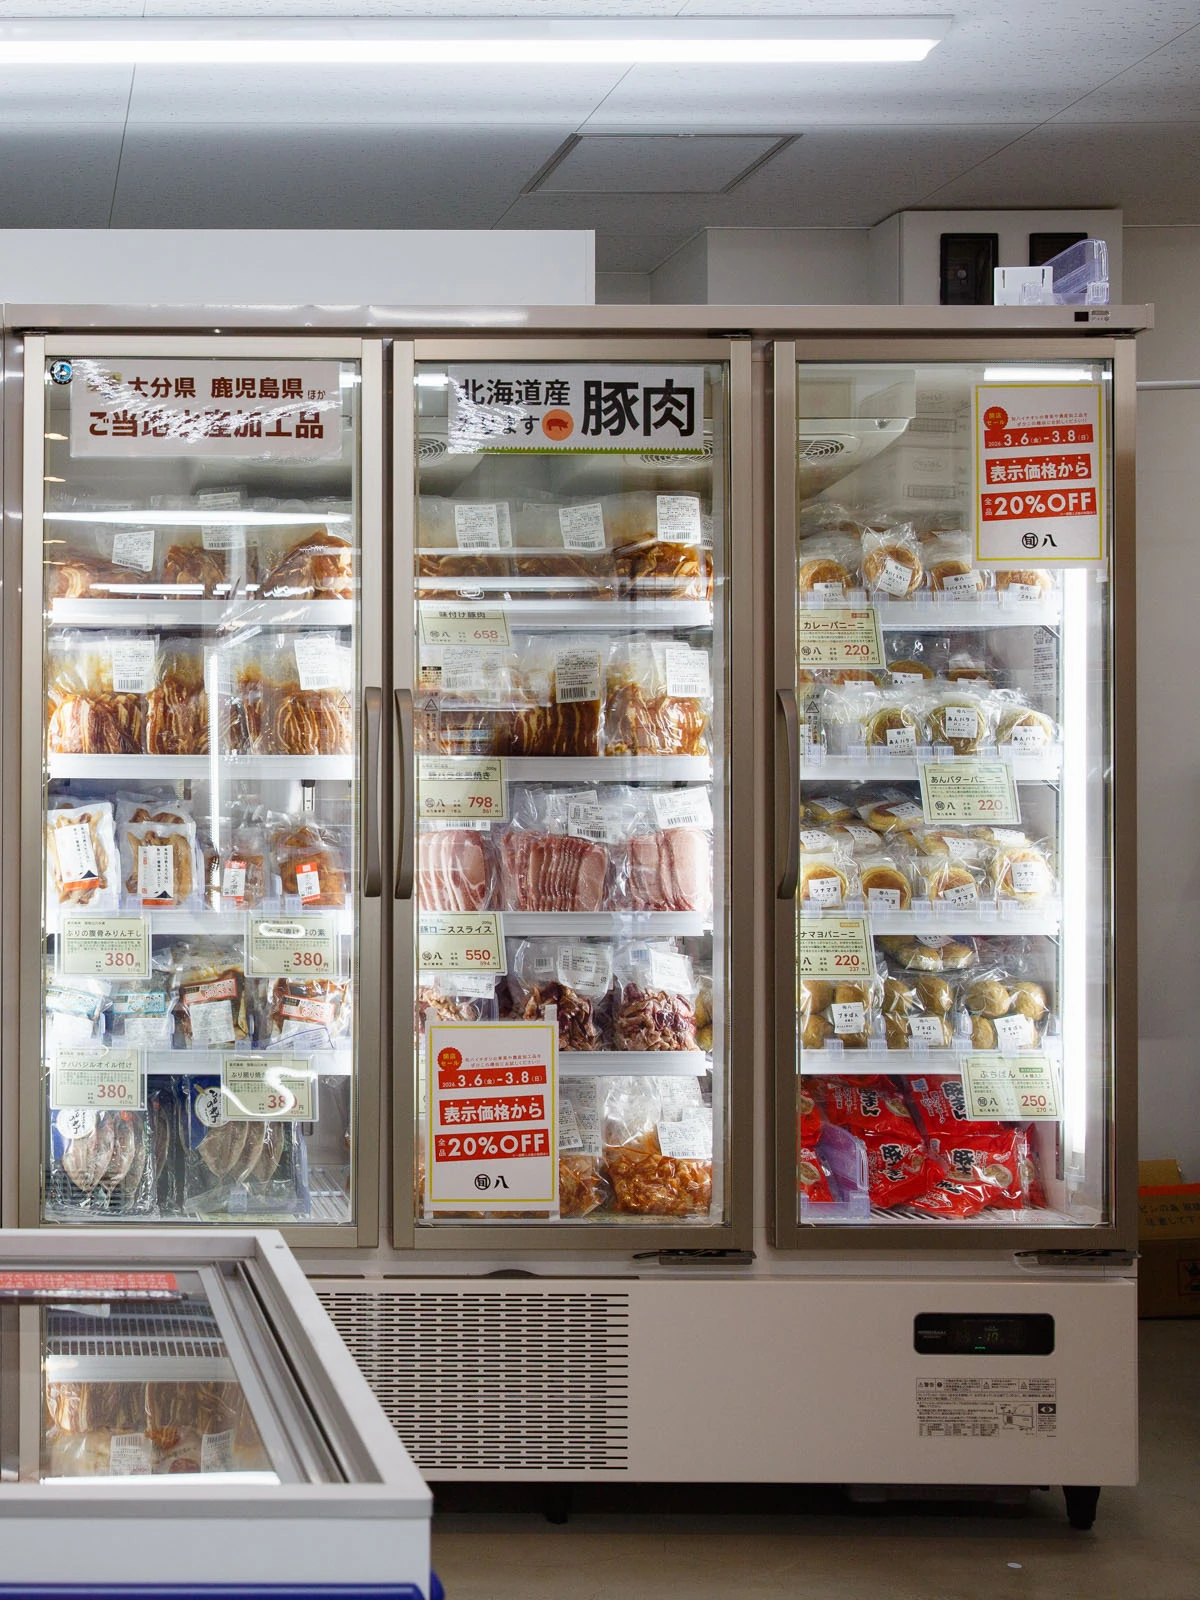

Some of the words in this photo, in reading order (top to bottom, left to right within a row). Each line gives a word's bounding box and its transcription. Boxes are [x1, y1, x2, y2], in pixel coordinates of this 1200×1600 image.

[128, 377, 196, 398] 大分県
[210, 376, 304, 400] 鹿児島県
[308, 389, 326, 400] ほか
[458, 379, 570, 406] 北海道産
[581, 379, 695, 437] 豚肉
[990, 461, 1089, 482] 表示価格から
[994, 492, 1091, 516] 20%OFF
[1022, 532, 1057, 549] 旬八
[474, 630, 498, 639] 658
[844, 644, 870, 656] 220
[468, 796, 492, 808] 798
[978, 800, 1002, 810] 220
[466, 950, 490, 960] 550
[834, 954, 860, 966] 220
[441, 1060, 460, 1068] セール
[1021, 1096, 1046, 1106] 250
[444, 1102, 542, 1124] 表示価格から
[448, 1133, 544, 1156] 20%OFF
[474, 1174, 510, 1190] 旬八
